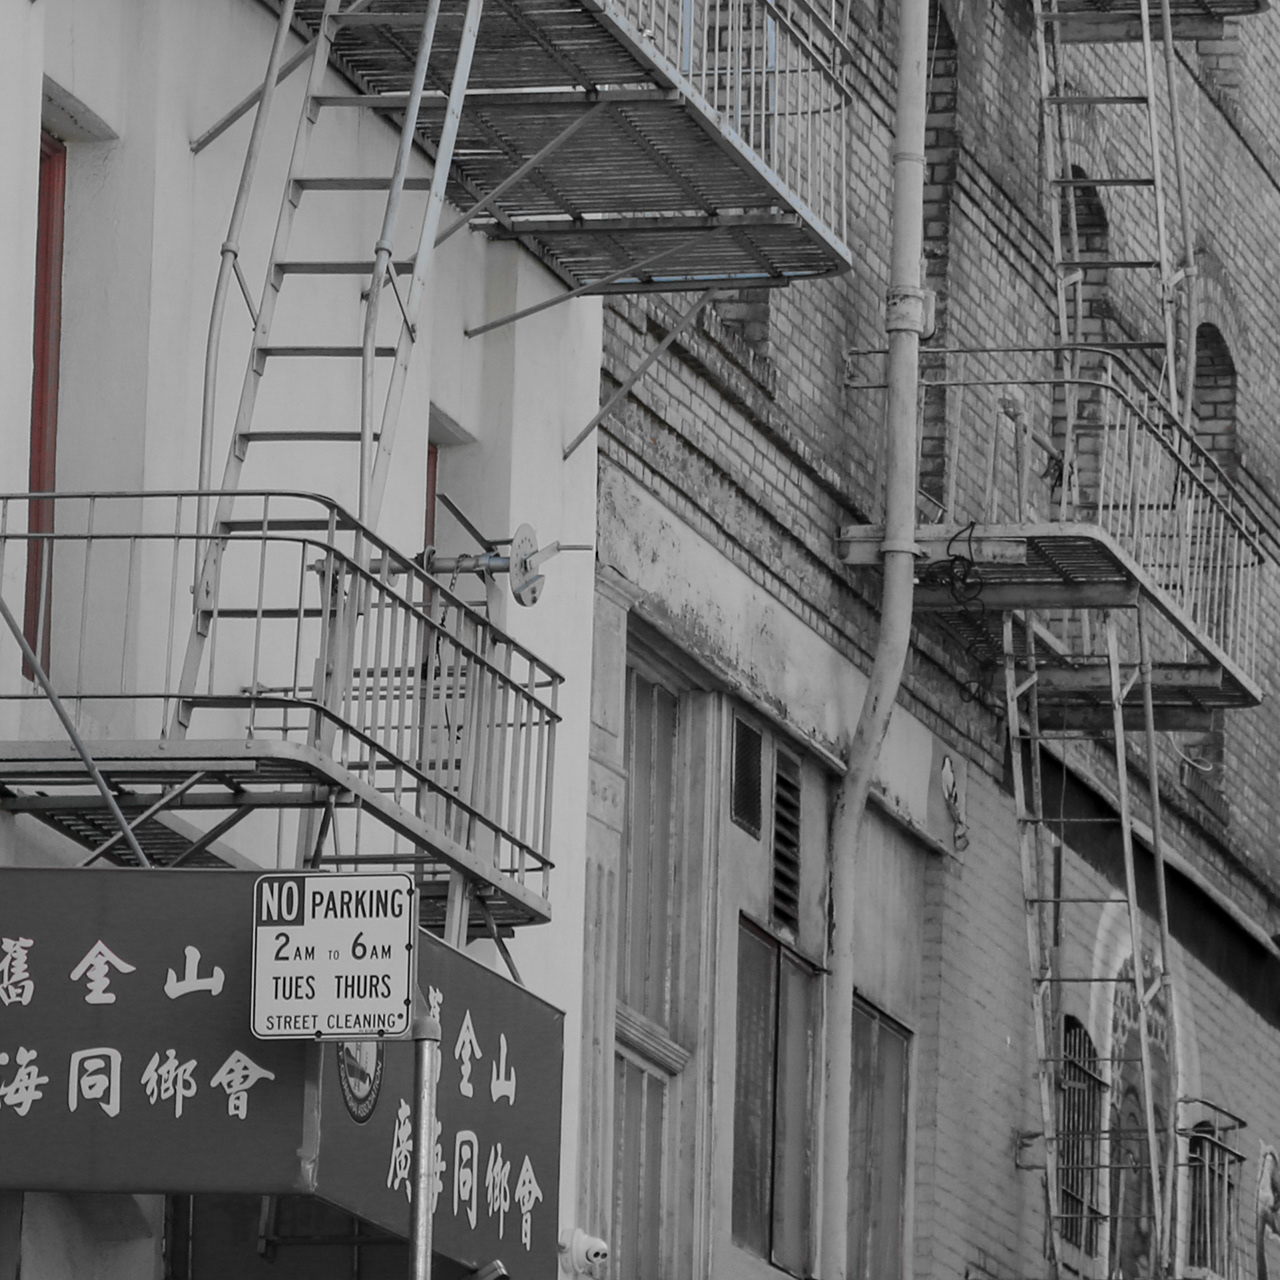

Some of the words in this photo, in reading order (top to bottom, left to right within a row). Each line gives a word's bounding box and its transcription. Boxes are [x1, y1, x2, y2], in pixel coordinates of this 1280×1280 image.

[261, 881, 299, 921] NO
[311, 888, 403, 919] PARKING
[328, 950, 340, 960] TO
[272, 975, 316, 1000] TUES
[334, 973, 392, 999] THURS
[266, 1015, 318, 1031] STREET
[326, 1013, 396, 1030] CLEANING
